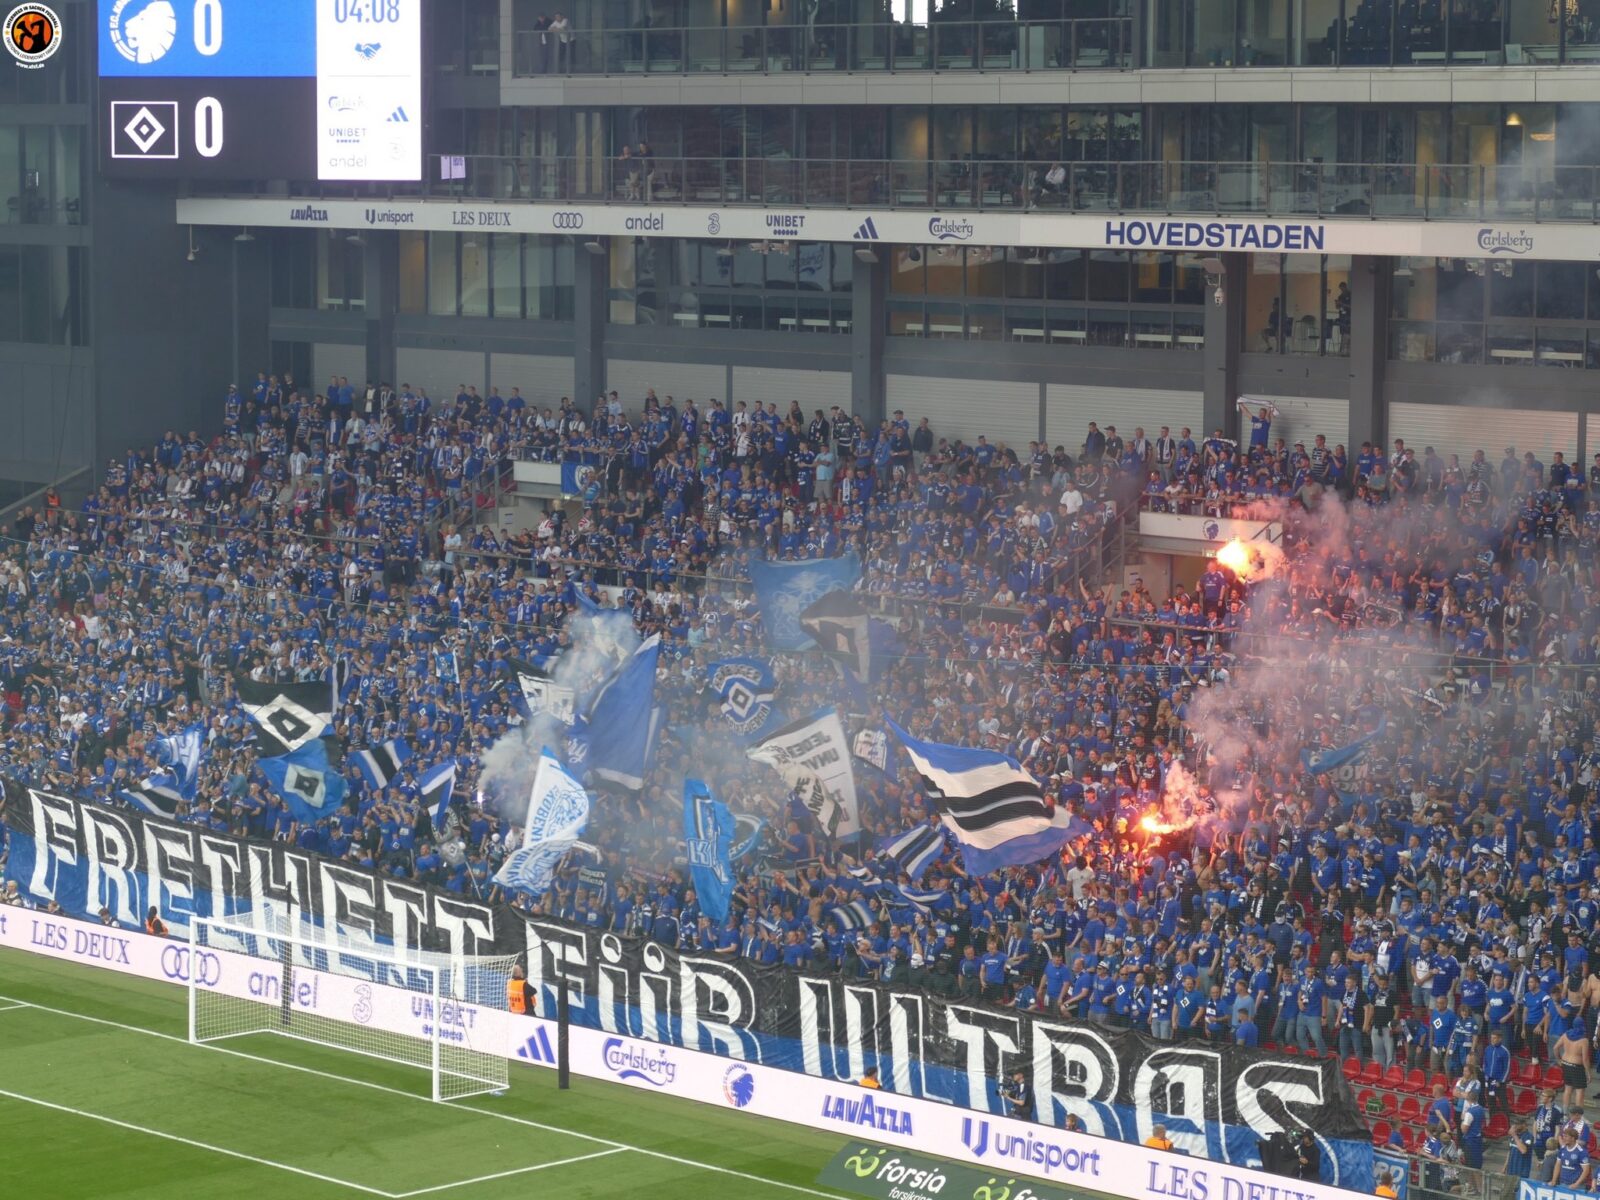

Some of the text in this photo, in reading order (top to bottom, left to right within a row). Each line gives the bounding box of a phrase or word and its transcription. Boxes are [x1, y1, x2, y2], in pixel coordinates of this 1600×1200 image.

[334, 0, 400, 23] 04:08
[194, 0, 222, 55] 0
[194, 97, 223, 157] 0
[329, 128, 367, 137] UNIBET
[329, 155, 367, 168] andel
[290, 205, 328, 221] LAVAZZA
[378, 209, 414, 225] unisport
[452, 211, 512, 227] LES DEUX
[625, 213, 664, 231] andel
[765, 215, 806, 229] UNIBET
[929, 217, 974, 239] Carlsberg
[1105, 221, 1325, 251] HOVEDSTADEN
[1477, 228, 1533, 252] Carlsberg
[31, 920, 68, 951] LES
[73, 929, 130, 965] DEUX
[411, 996, 477, 1029] UNBET
[525, 920, 763, 1064] FÜR
[799, 976, 1339, 1187] ULTRAS
[602, 1037, 676, 1084] Carlsberg
[821, 1093, 913, 1136] LAVAZZA
[995, 1131, 1100, 1177] unisport
[877, 1158, 947, 1195] forsia
[1146, 1160, 1209, 1200] LES
